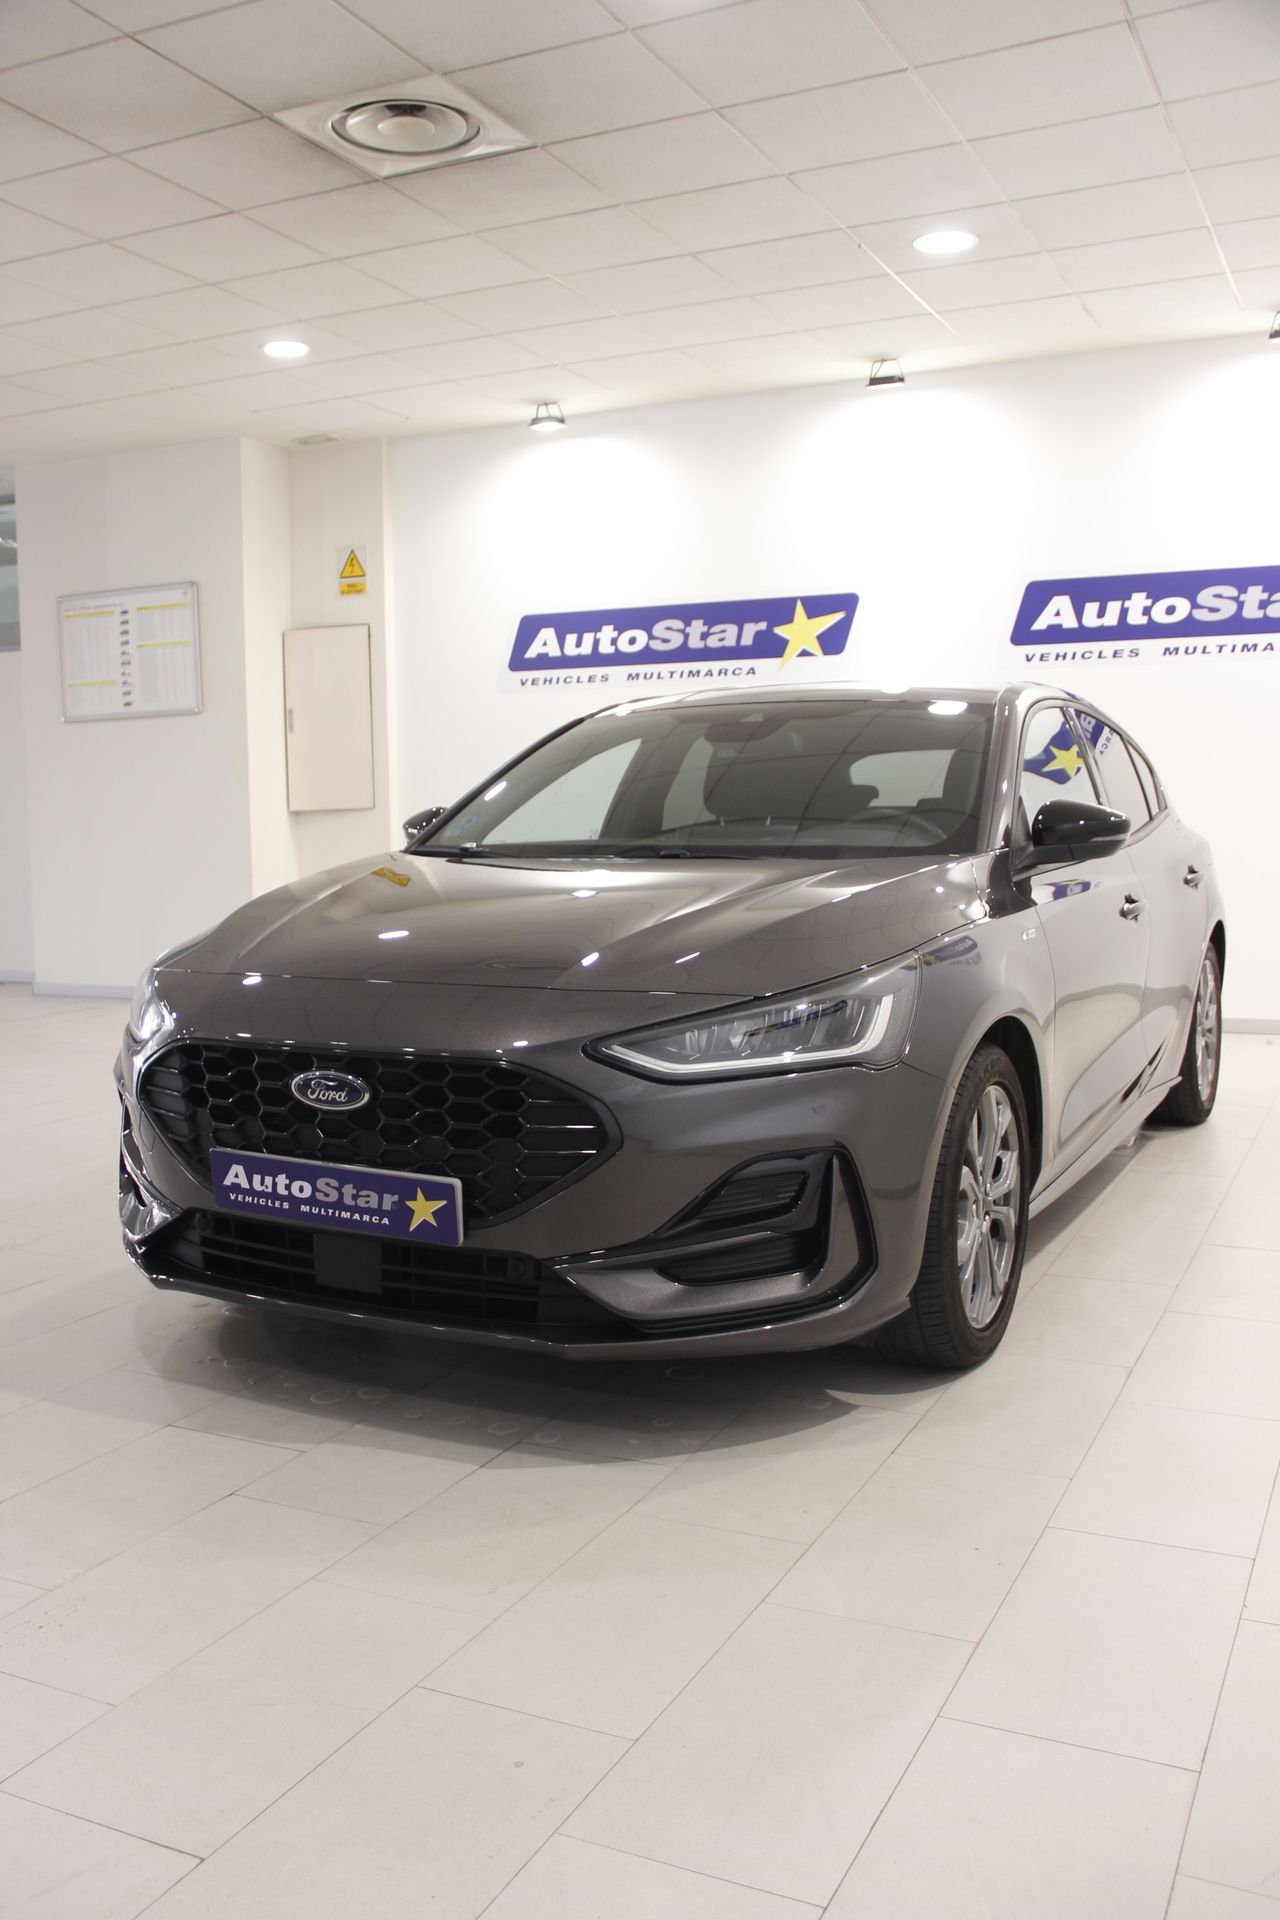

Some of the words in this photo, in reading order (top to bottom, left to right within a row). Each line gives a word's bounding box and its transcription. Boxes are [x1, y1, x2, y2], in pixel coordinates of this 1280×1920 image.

[524, 619, 767, 659] AutoStar
[1025, 648, 1141, 663] VEHICLES
[1162, 642, 1280, 657] MULTIMA
[519, 673, 610, 687] VEHICLES
[626, 667, 757, 681] MULTIMARCA
[308, 1079, 349, 1102] Ford
[223, 1164, 399, 1211] AutoStar
[229, 1192, 290, 1210] VEHICLES
[300, 1204, 390, 1225] MULTIMARCA
